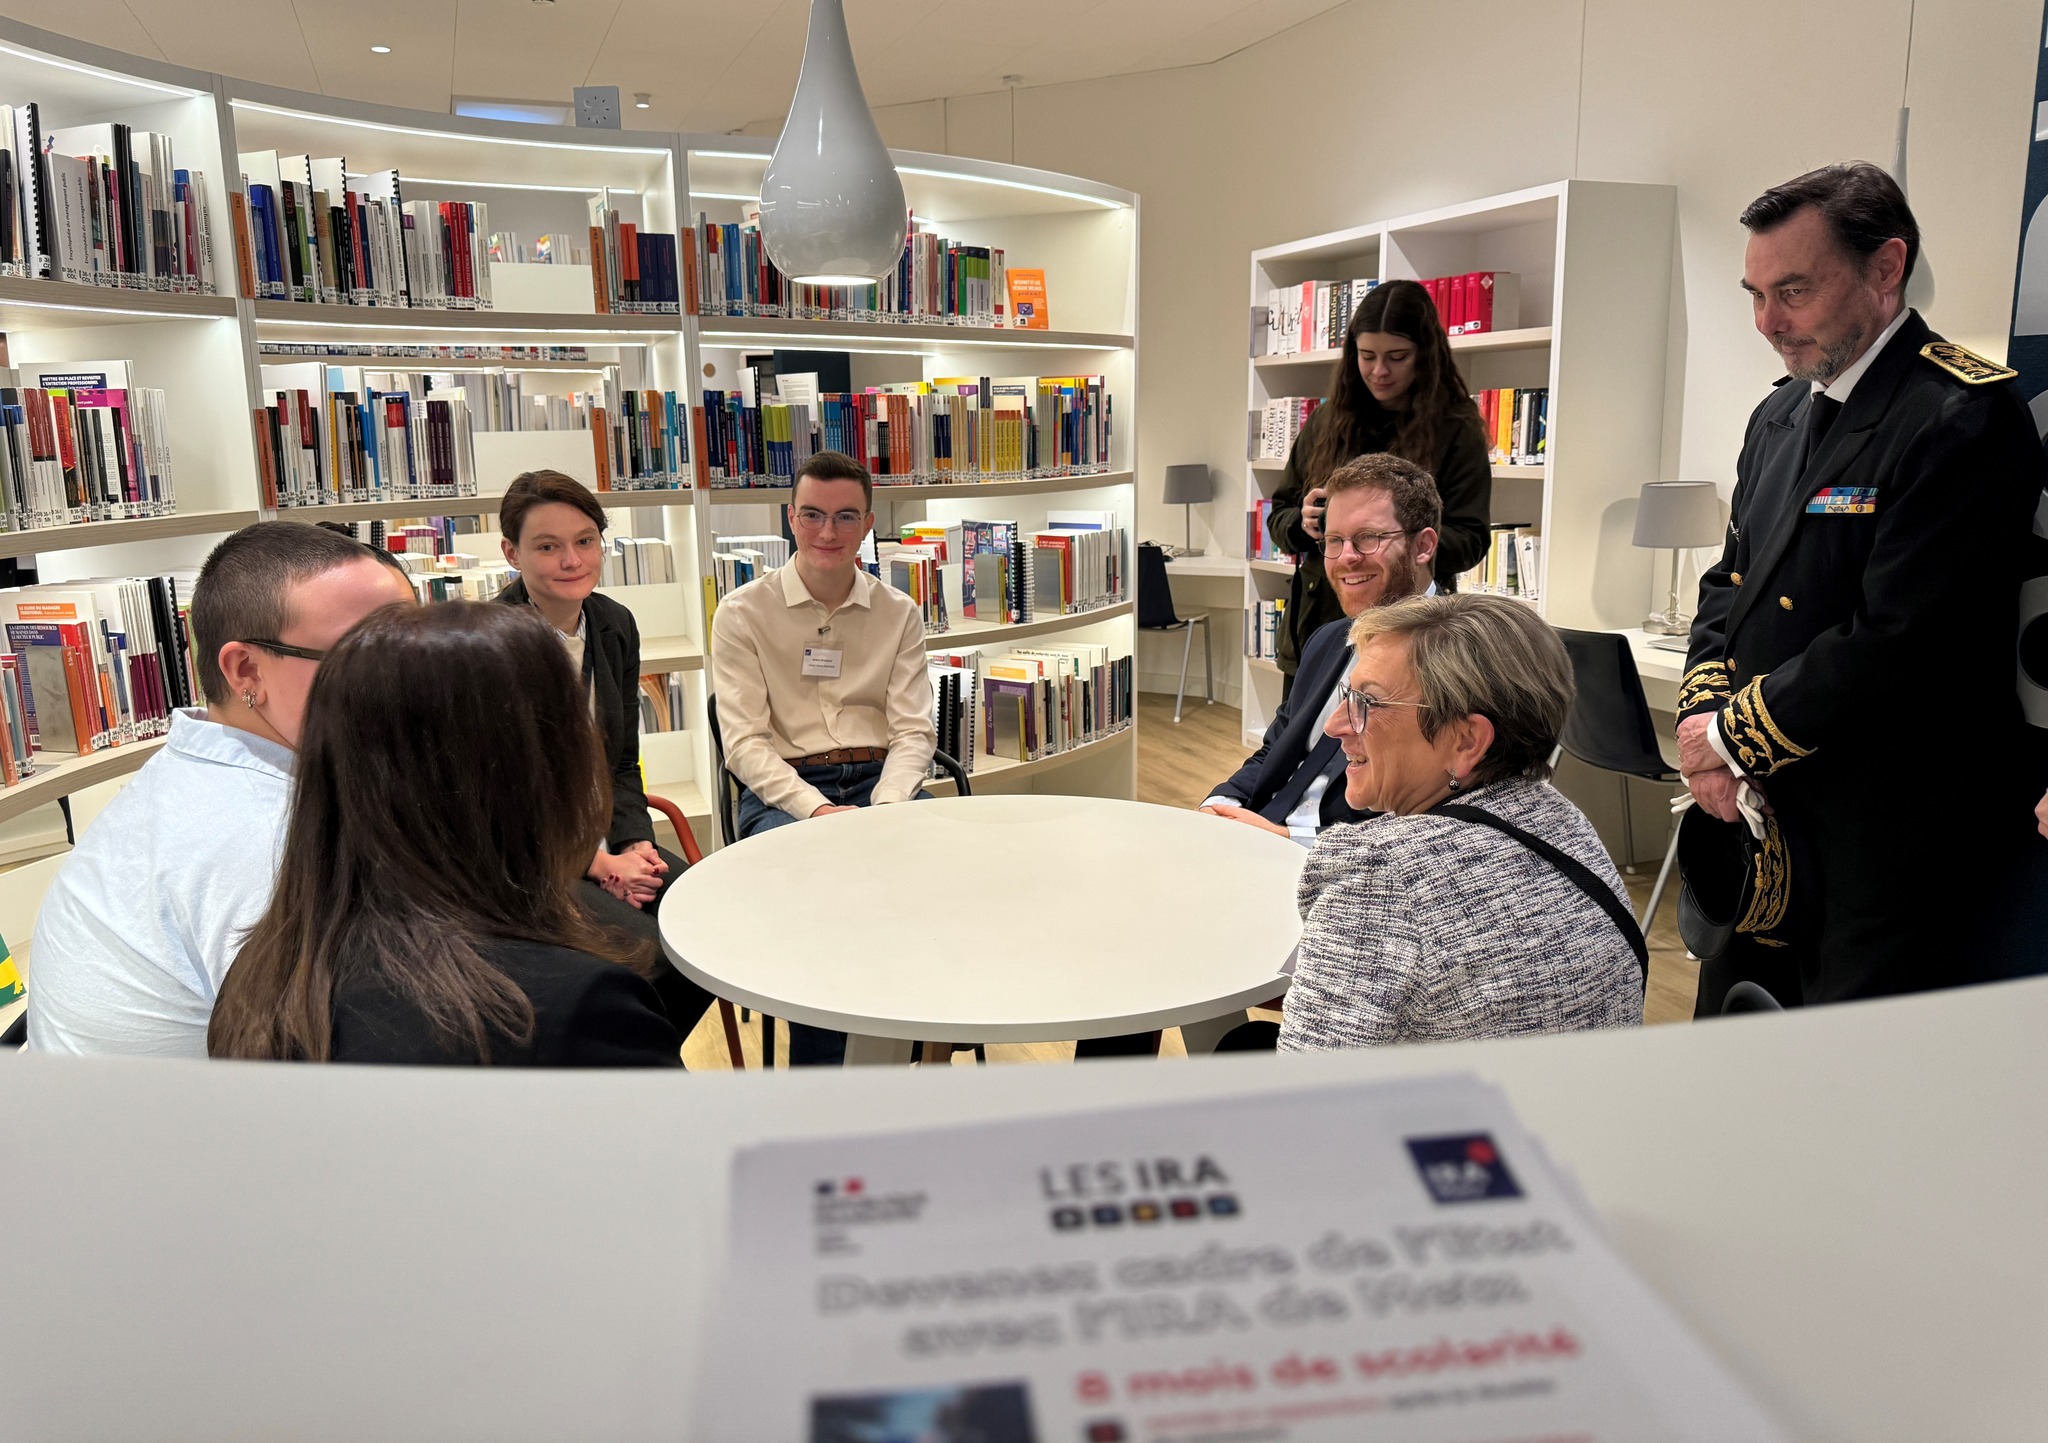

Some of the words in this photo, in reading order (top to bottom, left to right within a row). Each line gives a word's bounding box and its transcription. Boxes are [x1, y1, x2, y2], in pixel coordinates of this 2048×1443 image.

[66, 229, 74, 260] Encyclopédie
[81, 232, 89, 264] Encyclopédie
[1290, 400, 1299, 440] ROBERT
[1039, 1159, 1127, 1200] LES
[1134, 1154, 1230, 1191] IRA
[815, 1261, 1102, 1317] Devenez
[1114, 1237, 1297, 1288] cadre
[1304, 1229, 1394, 1273] de
[901, 1312, 1063, 1360] avec
[1258, 1284, 1350, 1327] de
[1126, 1357, 1258, 1399] mois
[1269, 1350, 1339, 1386] de
[1353, 1322, 1584, 1379] scolarité
